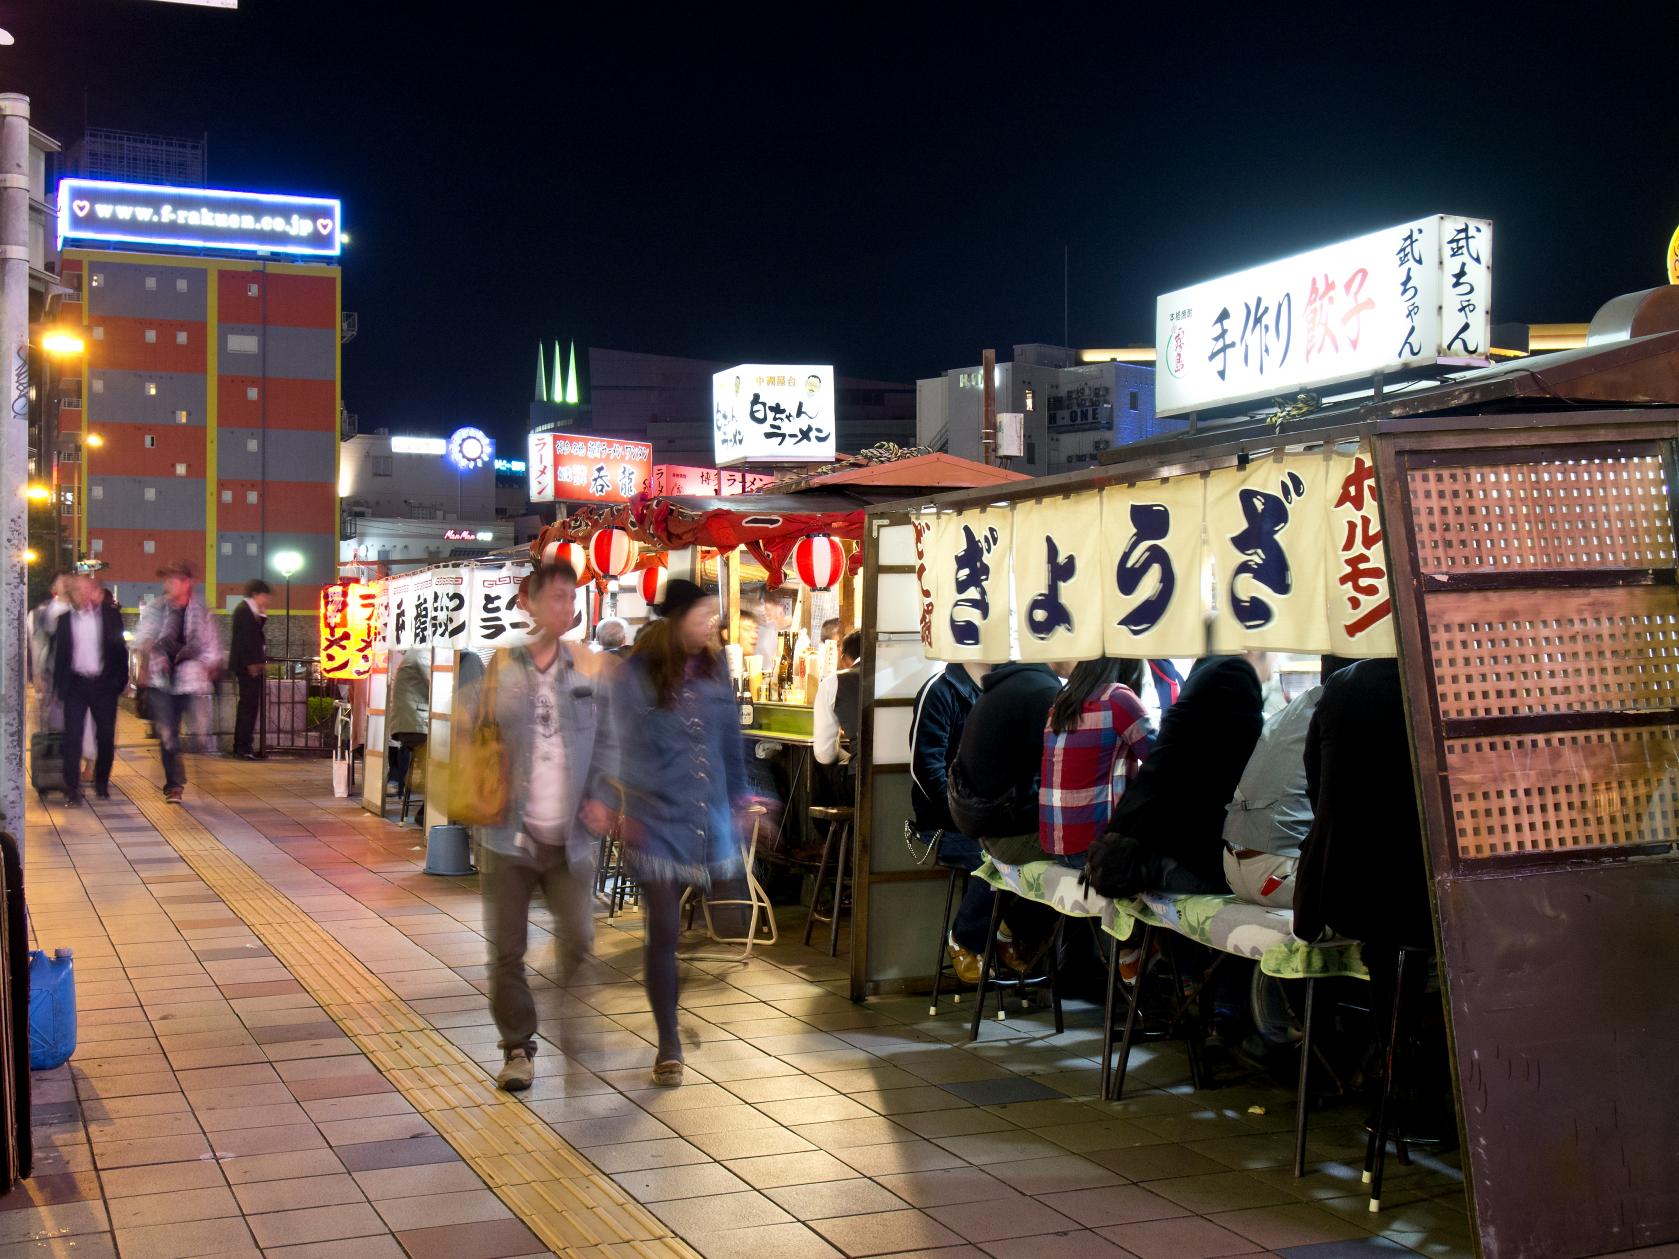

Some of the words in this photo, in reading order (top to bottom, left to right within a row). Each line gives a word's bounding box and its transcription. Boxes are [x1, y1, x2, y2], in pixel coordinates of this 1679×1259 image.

[95, 203, 313, 236] www.f-rakuen.co.jp
[1446, 222, 1482, 355] 武ちゃん
[763, 424, 831, 446] ラーメン
[534, 438, 549, 497] ラーメン
[1335, 456, 1392, 638] ホルモン
